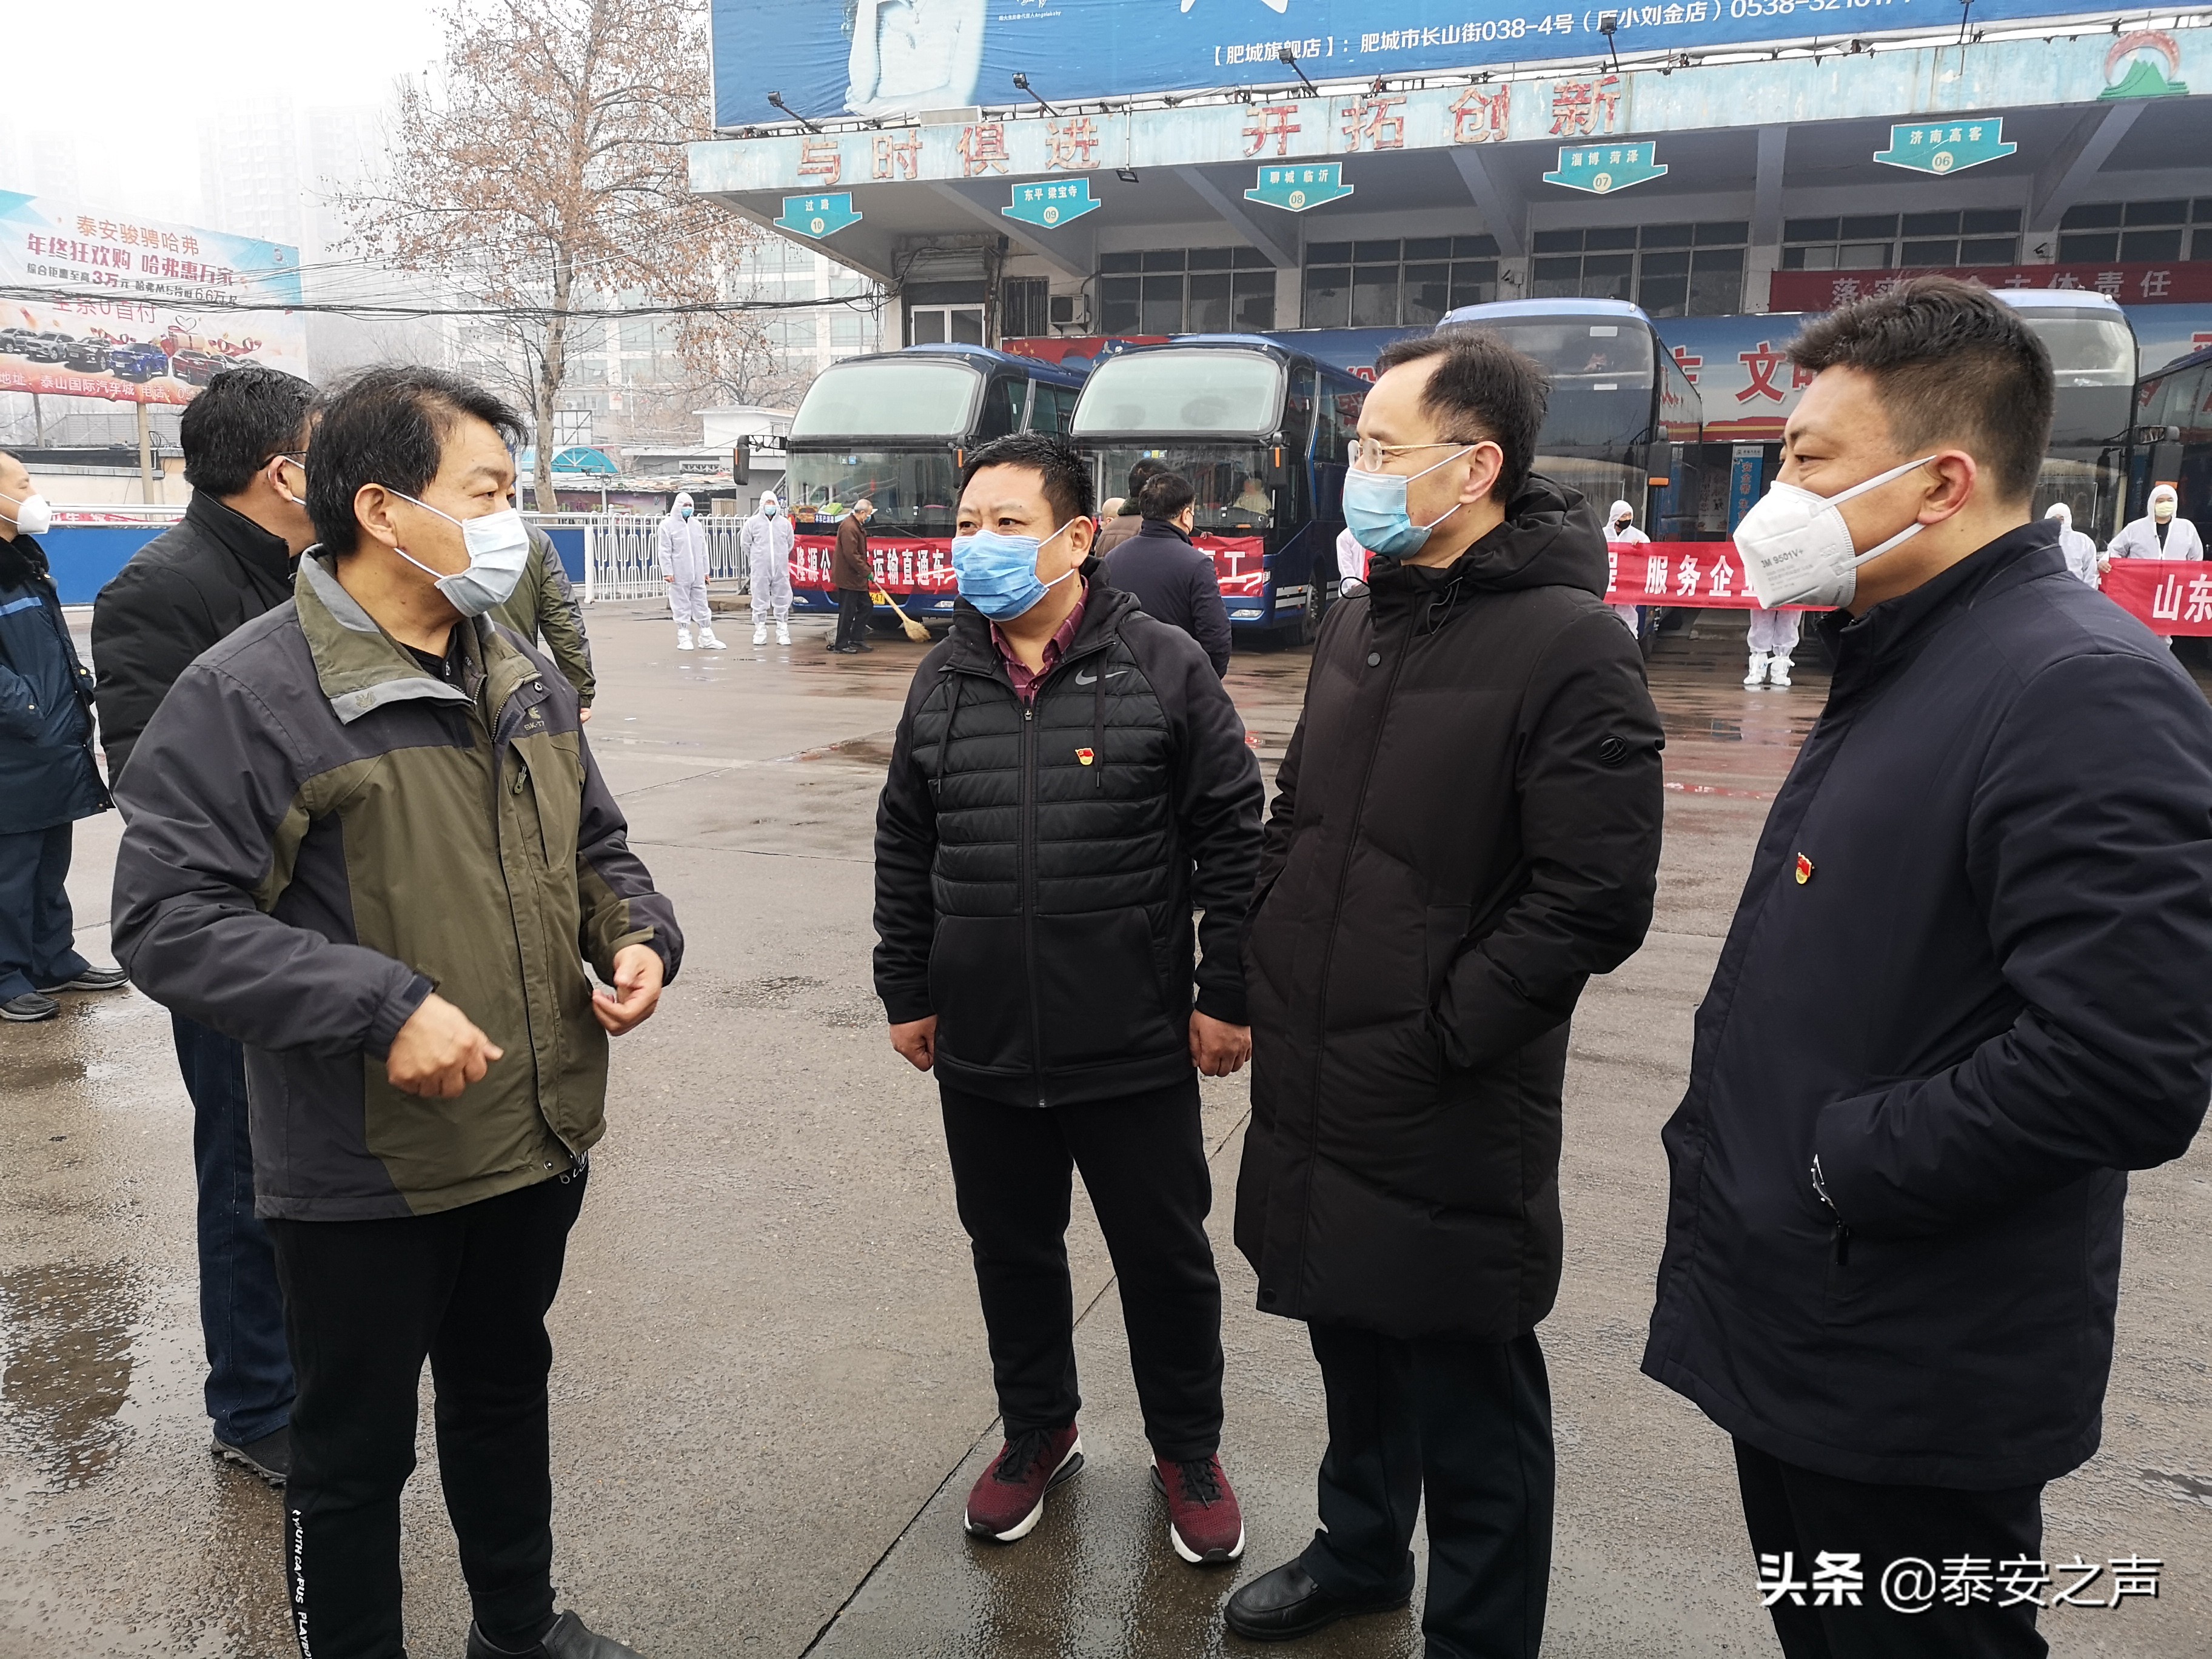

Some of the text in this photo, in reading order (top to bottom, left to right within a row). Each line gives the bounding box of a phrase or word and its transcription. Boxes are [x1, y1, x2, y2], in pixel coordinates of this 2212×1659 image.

[1242, 75, 1621, 156] 开拓创新
[1910, 126, 1982, 145] 济南高客
[797, 118, 1100, 185] 与时俱进
[1934, 156, 1951, 167] 06
[1595, 177, 1608, 187] 07
[1291, 195, 1303, 204] 08
[1046, 210, 1056, 219] 09
[813, 221, 822, 230] 10
